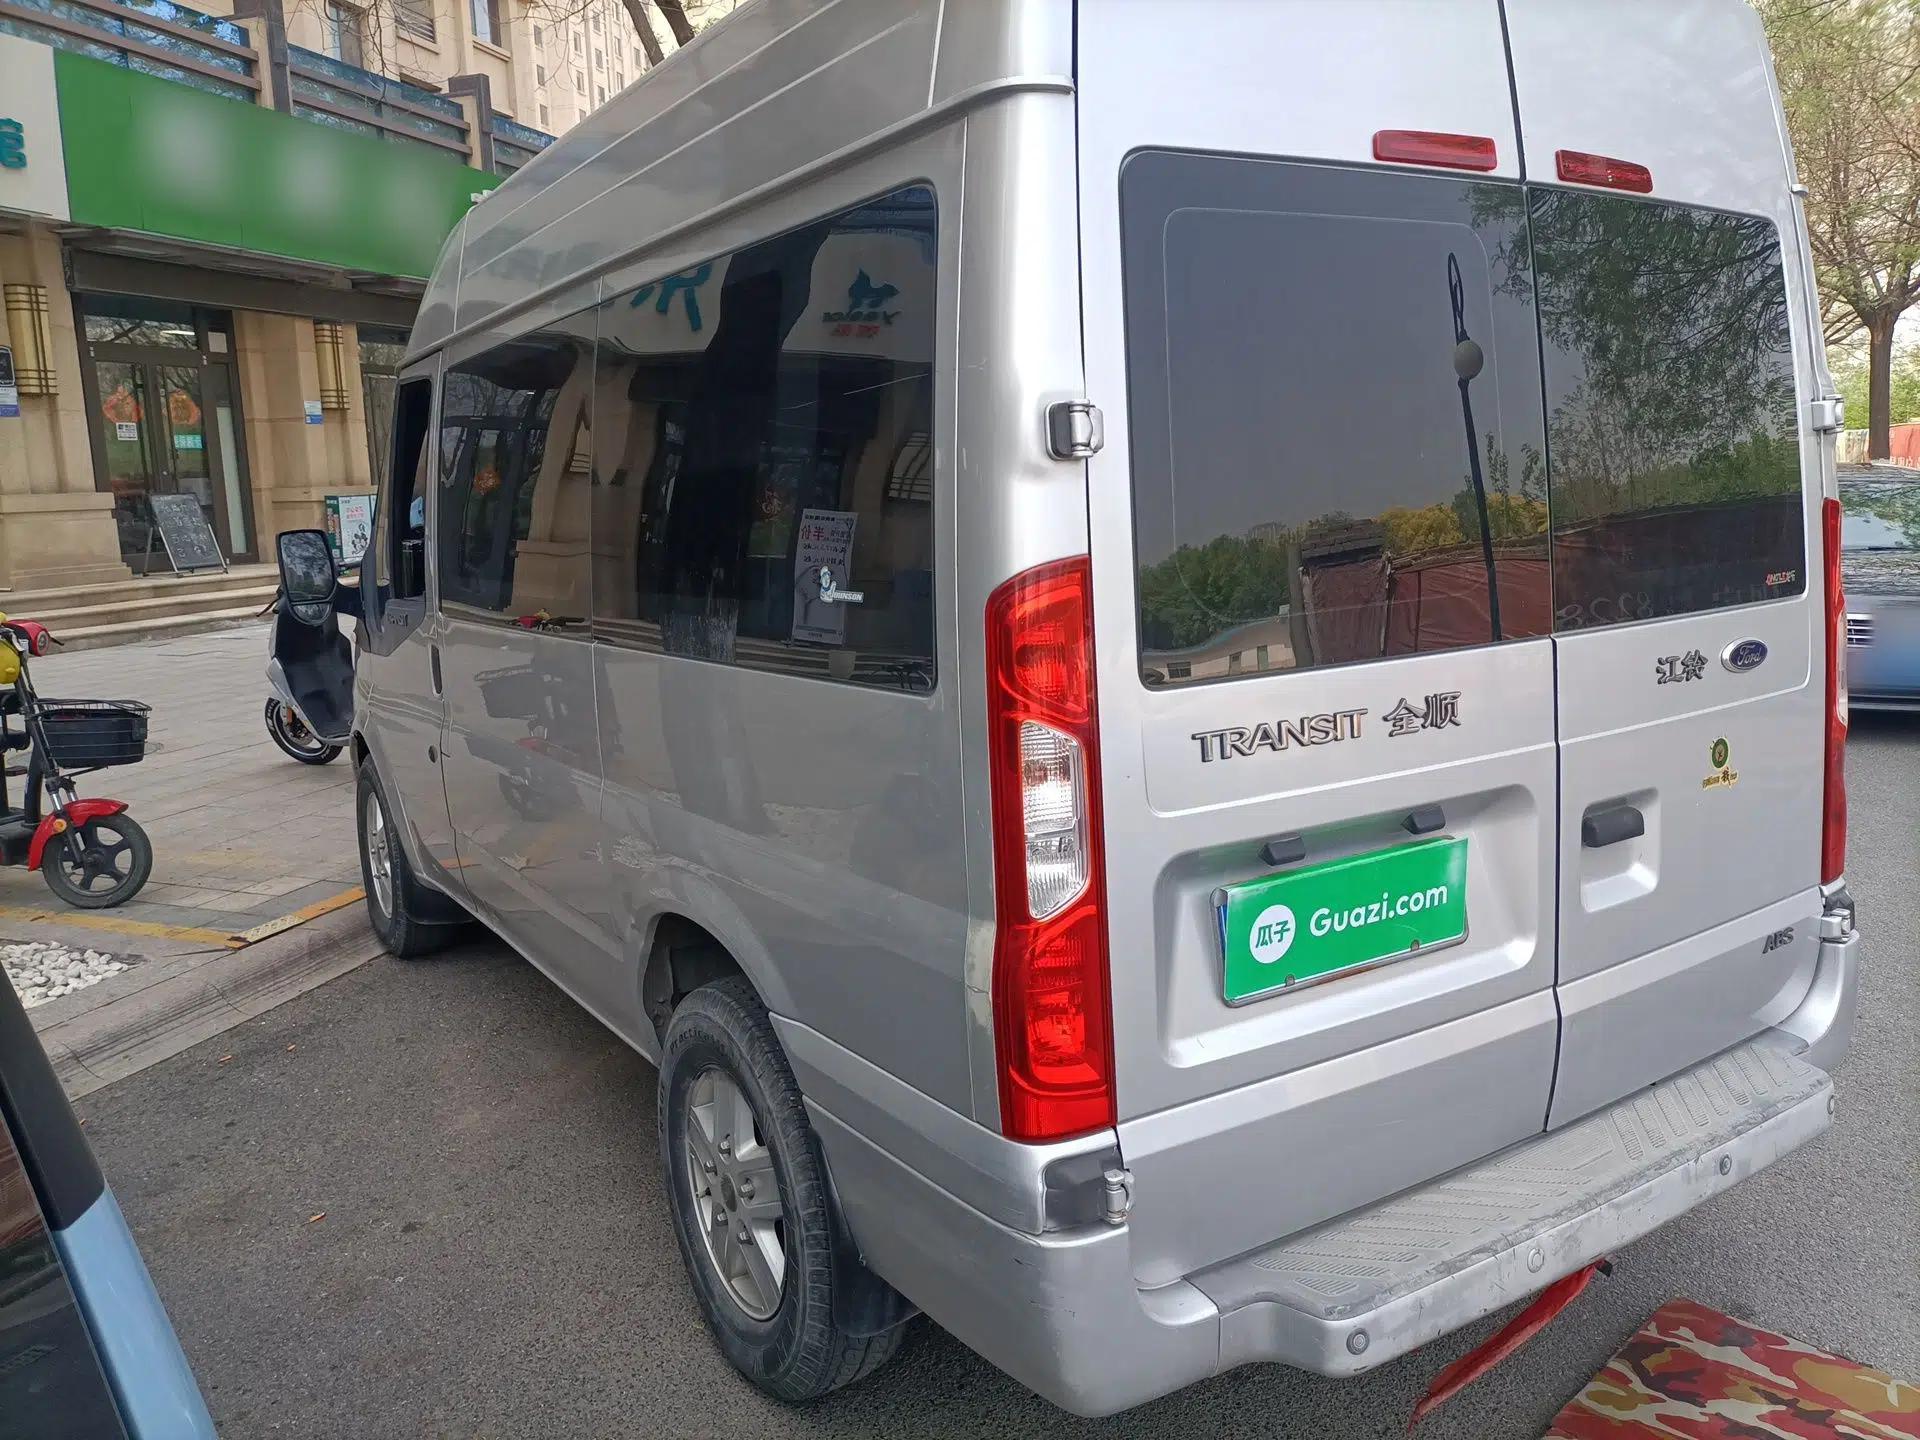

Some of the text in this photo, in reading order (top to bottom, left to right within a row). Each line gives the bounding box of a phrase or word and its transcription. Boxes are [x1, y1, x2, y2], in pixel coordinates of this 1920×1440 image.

[1655, 649, 1709, 685] 江铃
[1736, 644, 1763, 666] Ford
[1191, 690, 1463, 762] TRANSIT 全顺
[1308, 885, 1449, 938] Guazi.com
[1254, 919, 1291, 949] 瓜子
[1761, 926, 1795, 954] ABS
